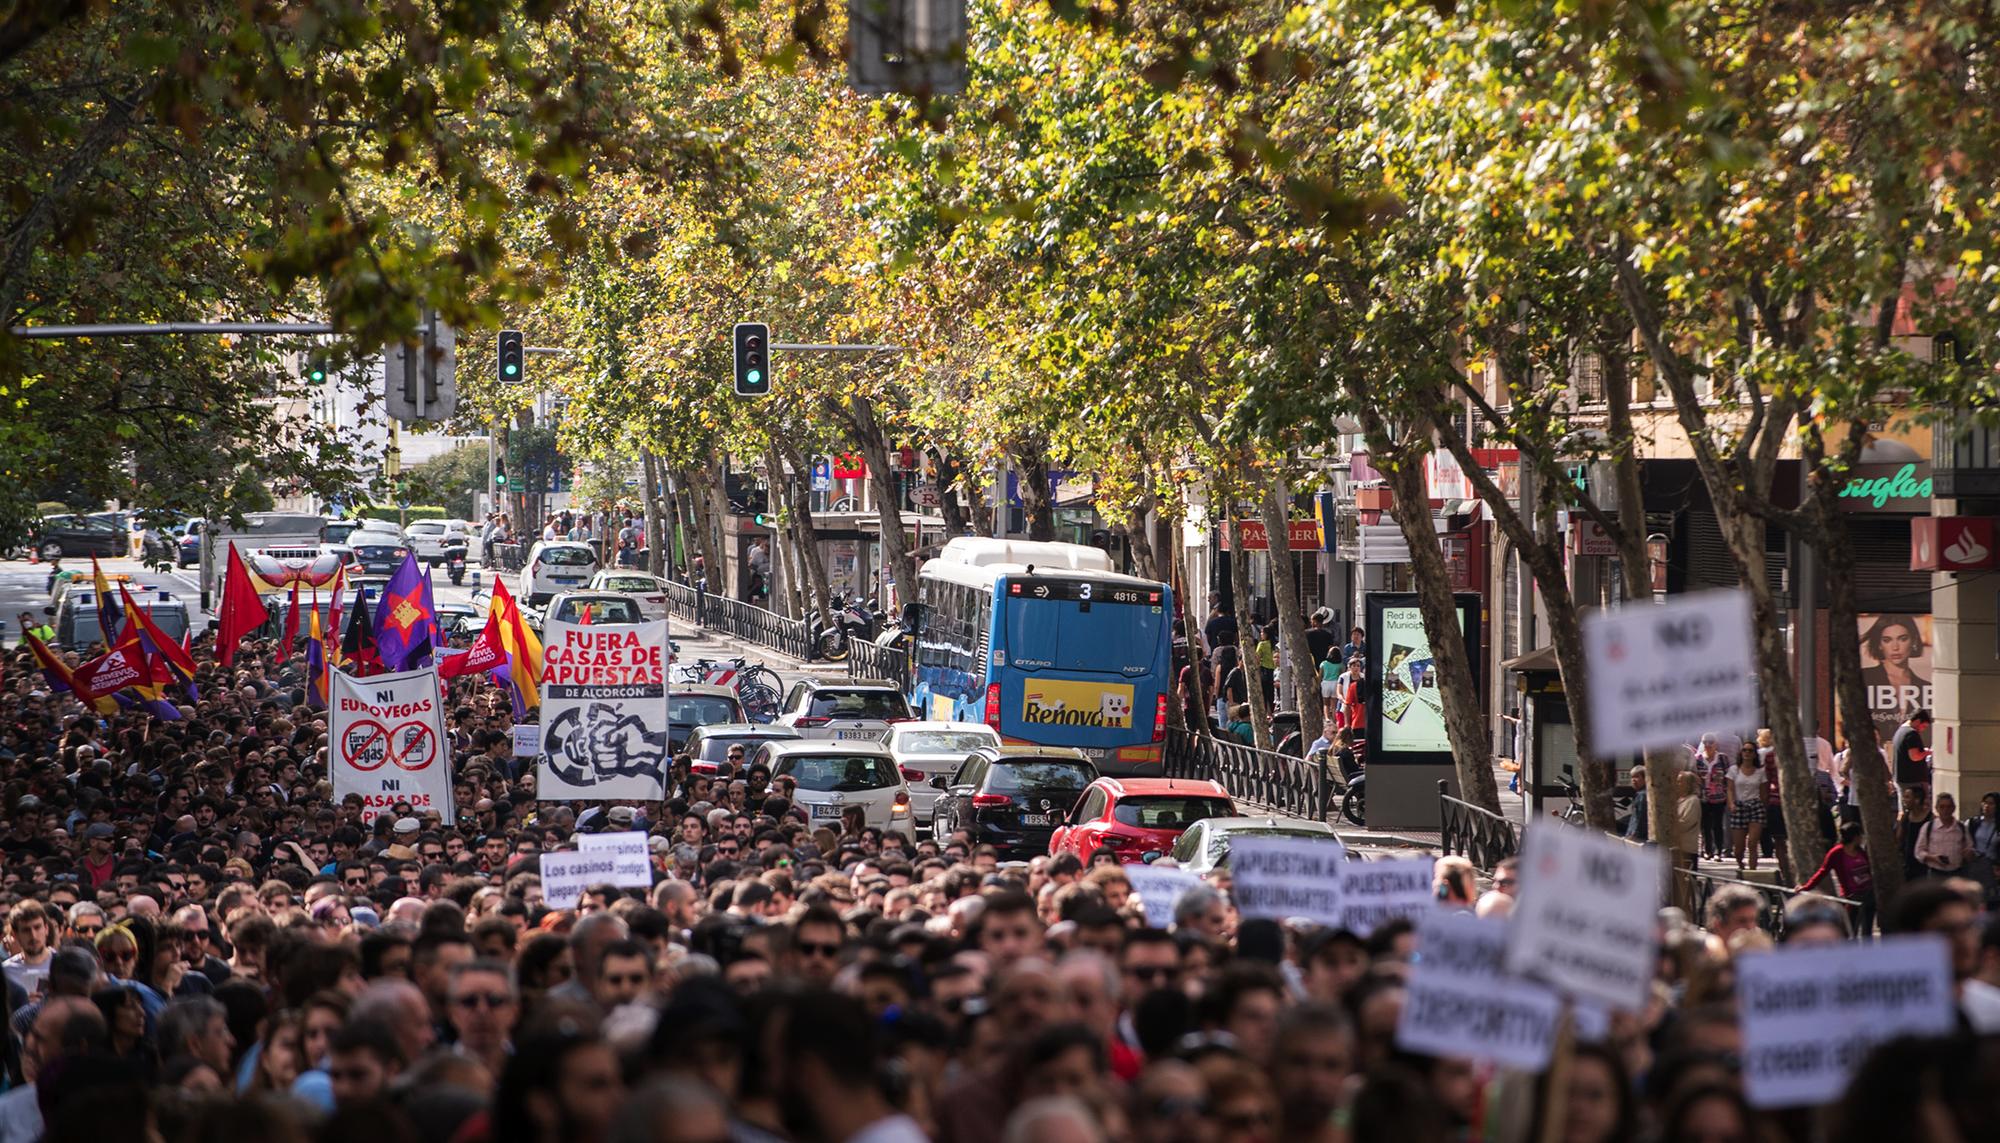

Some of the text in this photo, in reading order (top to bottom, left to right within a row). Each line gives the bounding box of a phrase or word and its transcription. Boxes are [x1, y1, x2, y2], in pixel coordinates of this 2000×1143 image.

[1838, 463, 1933, 508] uglas
[1242, 529, 1317, 541] PASLERI
[1079, 583, 1092, 600] 3
[1113, 591, 1138, 602] 4816
[1386, 611, 1417, 619] Red de
[566, 630, 641, 651] FUERA
[544, 645, 661, 666] CASAS DE
[1014, 659, 1052, 667] CITARO
[1122, 665, 1146, 673] NGT
[541, 665, 664, 685] APUESTAS
[376, 690, 394, 703] NI
[565, 687, 579, 697] DE
[1867, 685, 1933, 710] IBRE
[341, 698, 432, 719] EUROVEGAS
[843, 731, 861, 740] 9383
[382, 779, 400, 791] NI
[363, 794, 431, 808] ASAS DE
[544, 859, 614, 878] Los casinos
